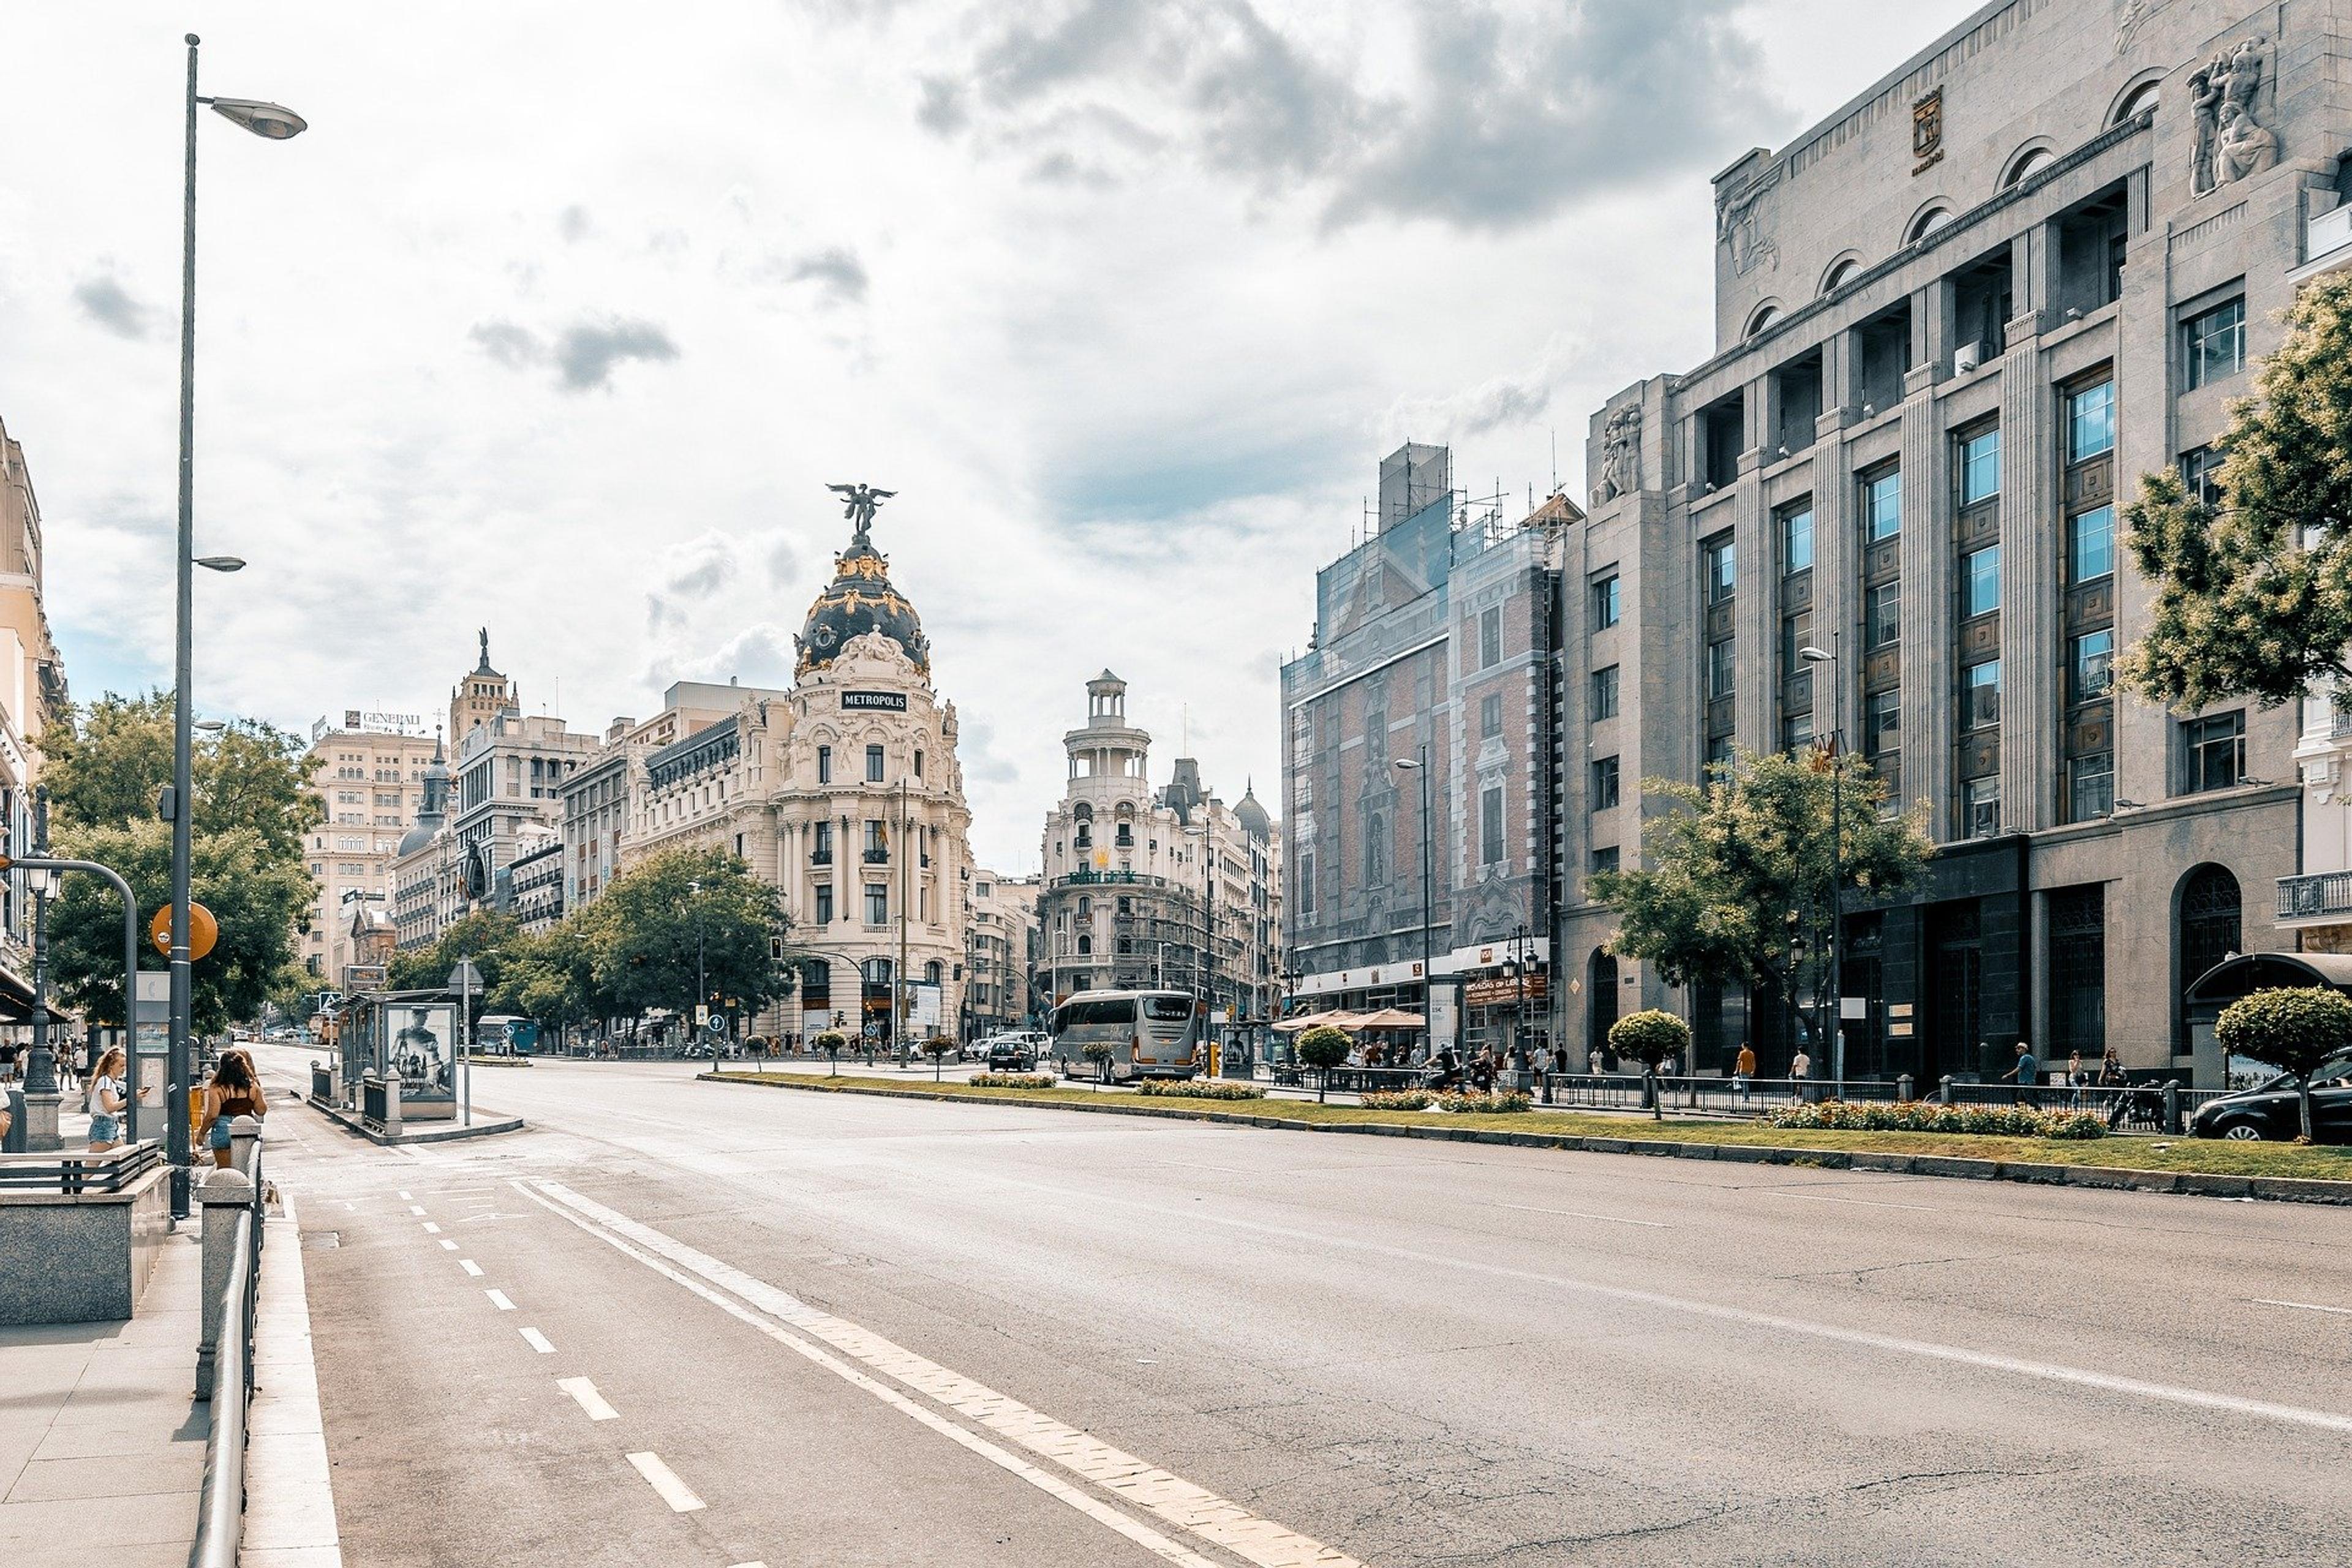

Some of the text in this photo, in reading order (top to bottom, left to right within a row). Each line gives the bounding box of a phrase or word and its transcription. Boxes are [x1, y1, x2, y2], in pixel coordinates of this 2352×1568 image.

[1912, 148, 1944, 177] madrid
[845, 695, 905, 707] METROPOLIS
[363, 712, 420, 725] GENERALI
[1068, 870, 1136, 884] ROLEX
